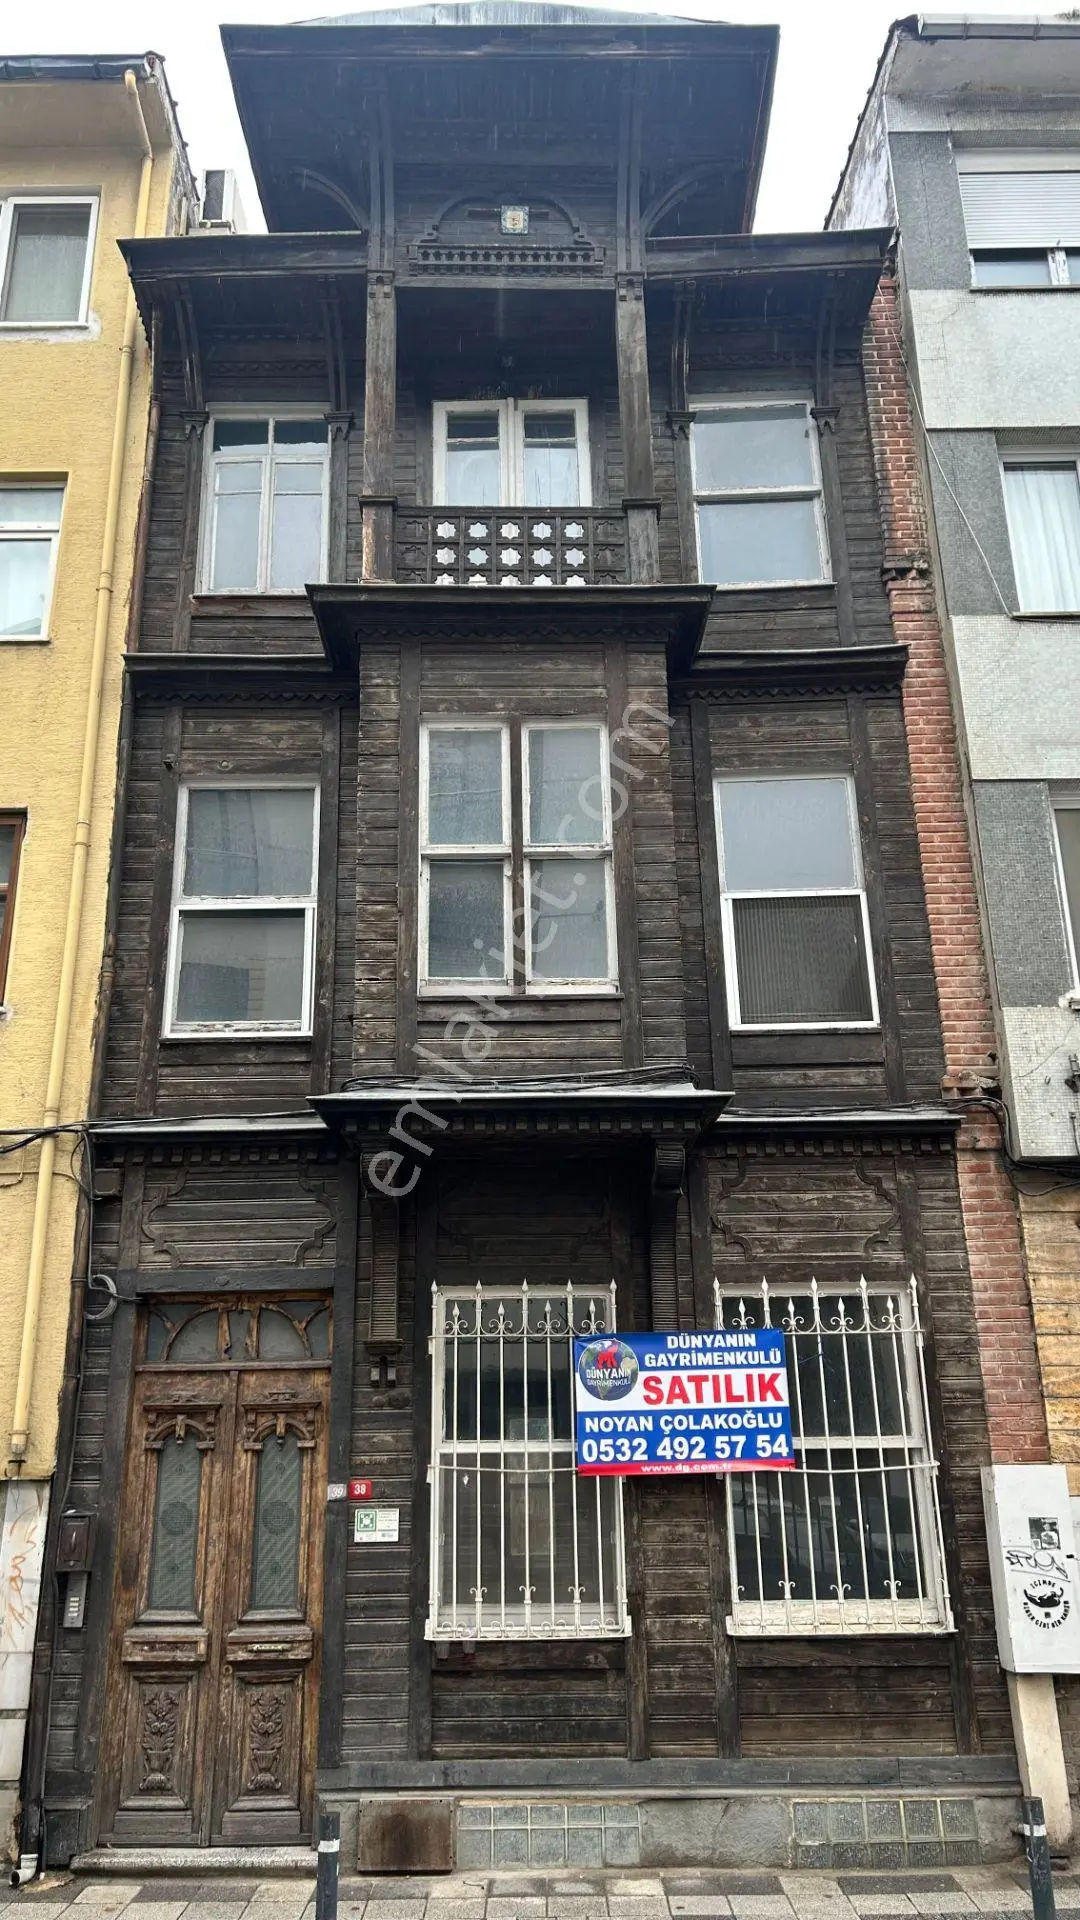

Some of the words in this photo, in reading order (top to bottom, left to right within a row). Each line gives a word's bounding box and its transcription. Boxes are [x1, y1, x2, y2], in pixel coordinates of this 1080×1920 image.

[667, 1333, 756, 1349] DÜNYANIN
[644, 1348, 782, 1368] GAYRİMENKULÜ
[643, 1373, 784, 1405] SATILIK
[585, 1416, 653, 1433] NOYAN
[659, 1410, 783, 1435] ÇOLAKOĞLU
[582, 1437, 648, 1463] 0532
[656, 1436, 707, 1460] 492
[715, 1435, 747, 1458] 57
[756, 1434, 789, 1458] 54
[331, 1487, 343, 1497] 39
[354, 1484, 366, 1495] 38
